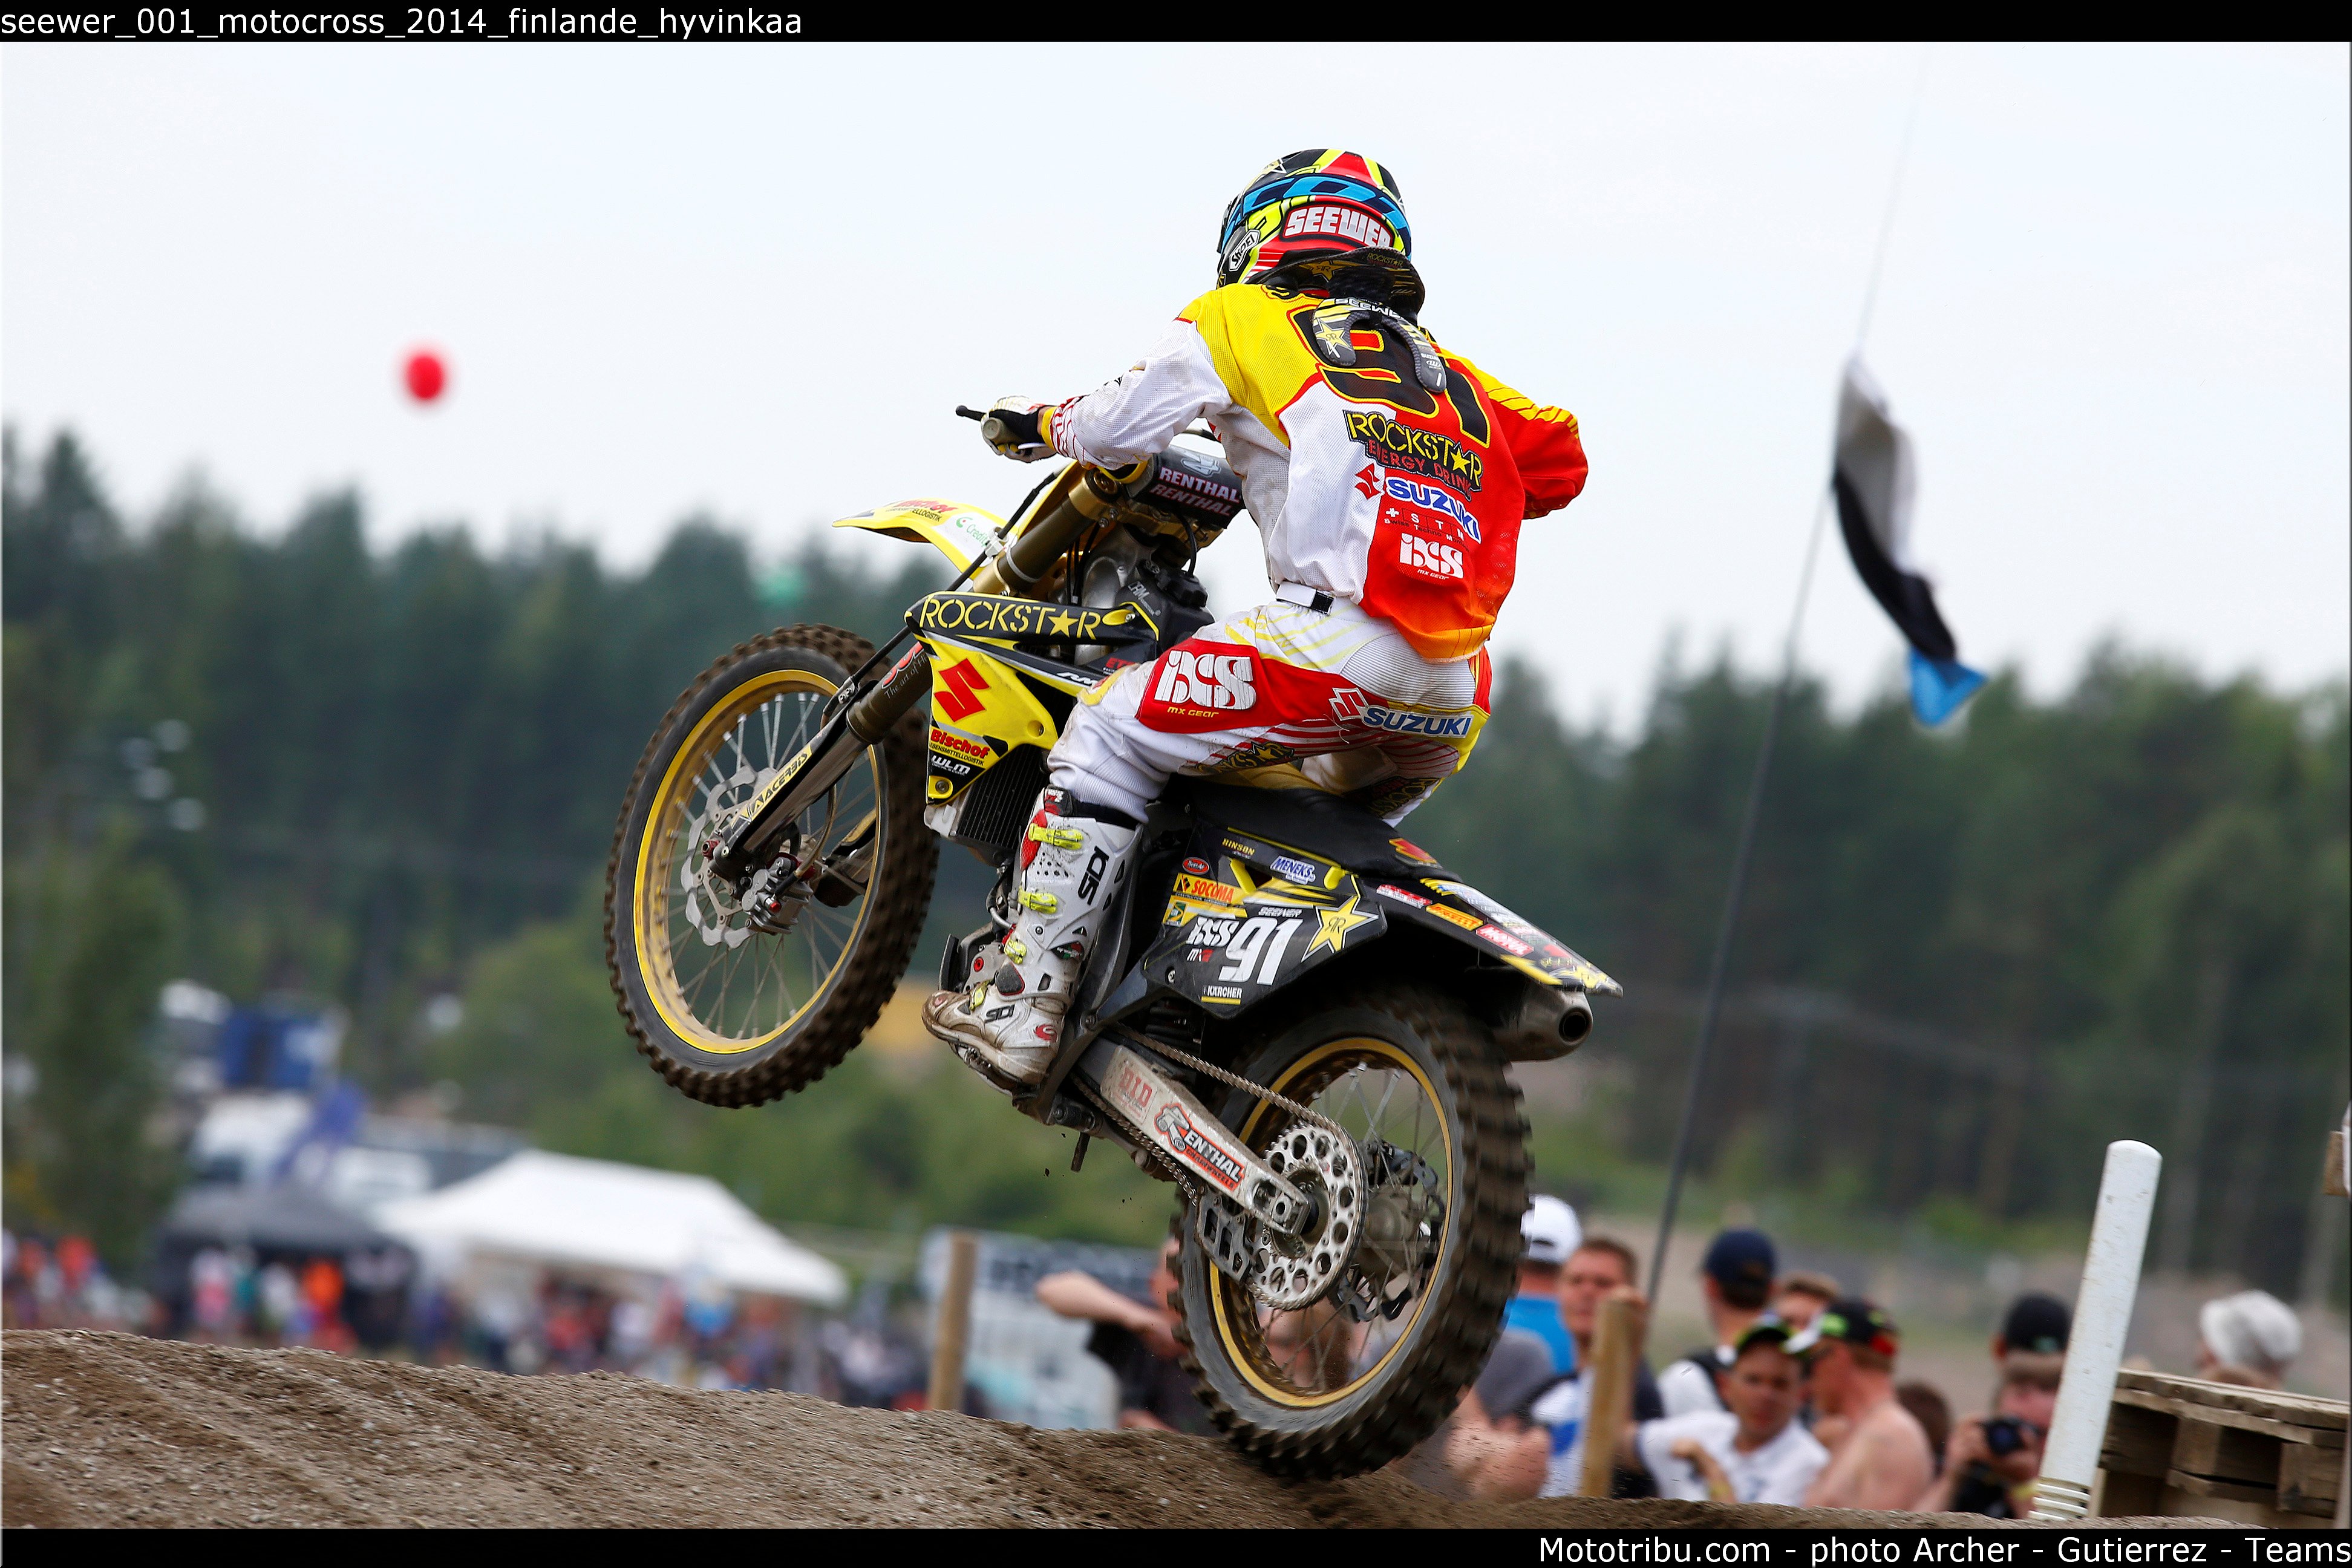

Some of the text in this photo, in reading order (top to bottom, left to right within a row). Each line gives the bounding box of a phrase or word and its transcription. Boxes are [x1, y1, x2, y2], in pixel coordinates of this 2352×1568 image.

[1149, 483, 1233, 517] RENTHAL
[1158, 466, 1240, 504] RENTHAL
[1387, 479, 1480, 541] SUZUKI
[884, 685, 900, 699] The
[1363, 707, 1472, 736] SUZUKI
[930, 728, 990, 759] Bischof
[1221, 838, 1255, 856] HINSON
[1271, 857, 1314, 878] MENEKS
[1191, 880, 1234, 904] SOCOMA
[1218, 916, 1304, 985] 91
